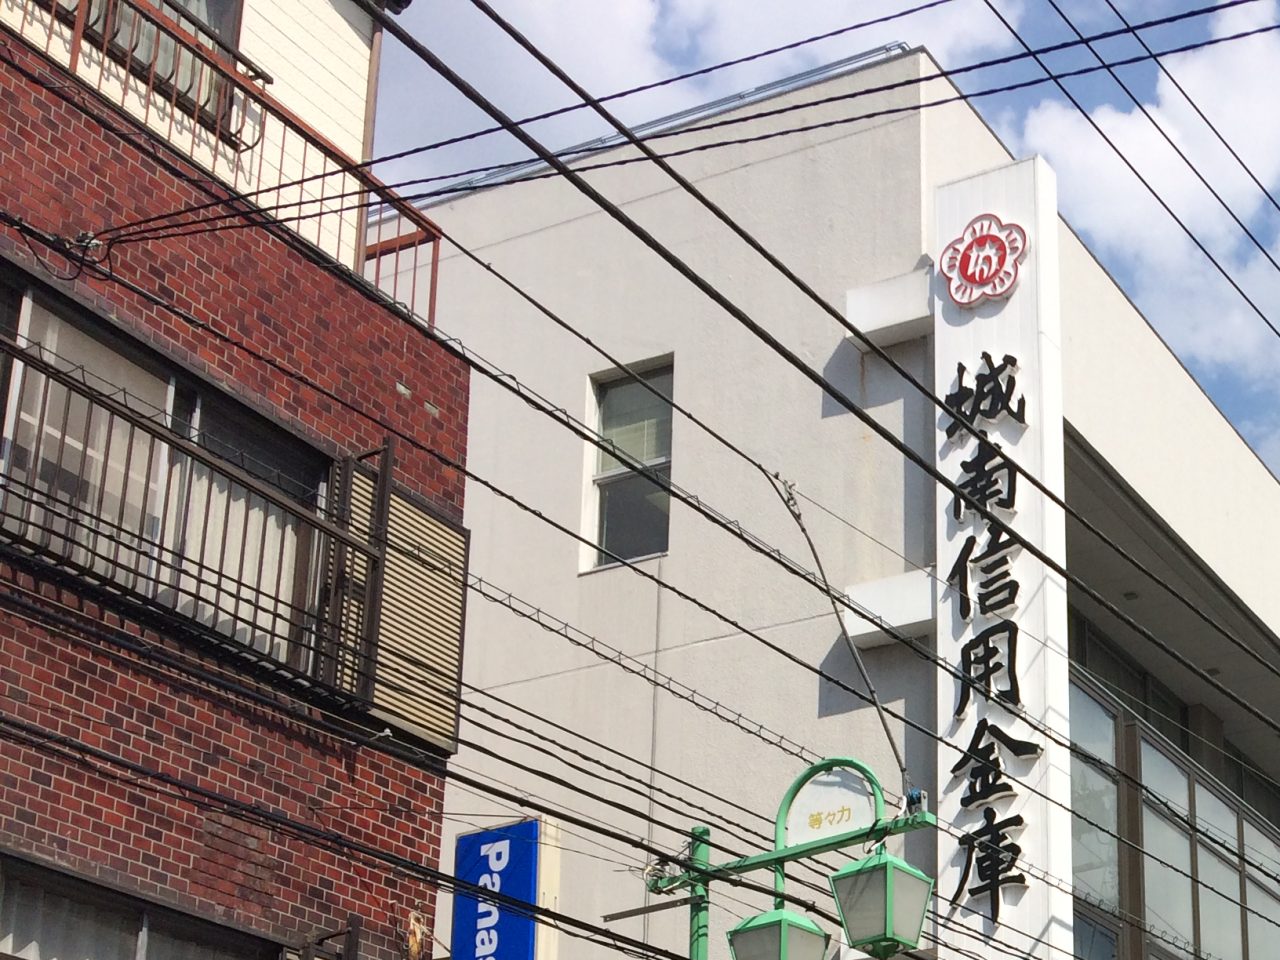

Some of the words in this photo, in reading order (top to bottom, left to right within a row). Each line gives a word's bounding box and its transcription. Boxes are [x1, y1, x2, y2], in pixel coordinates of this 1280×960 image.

[945, 352, 1044, 925] 城南信用金庫
[808, 806, 851, 829] 等々力
